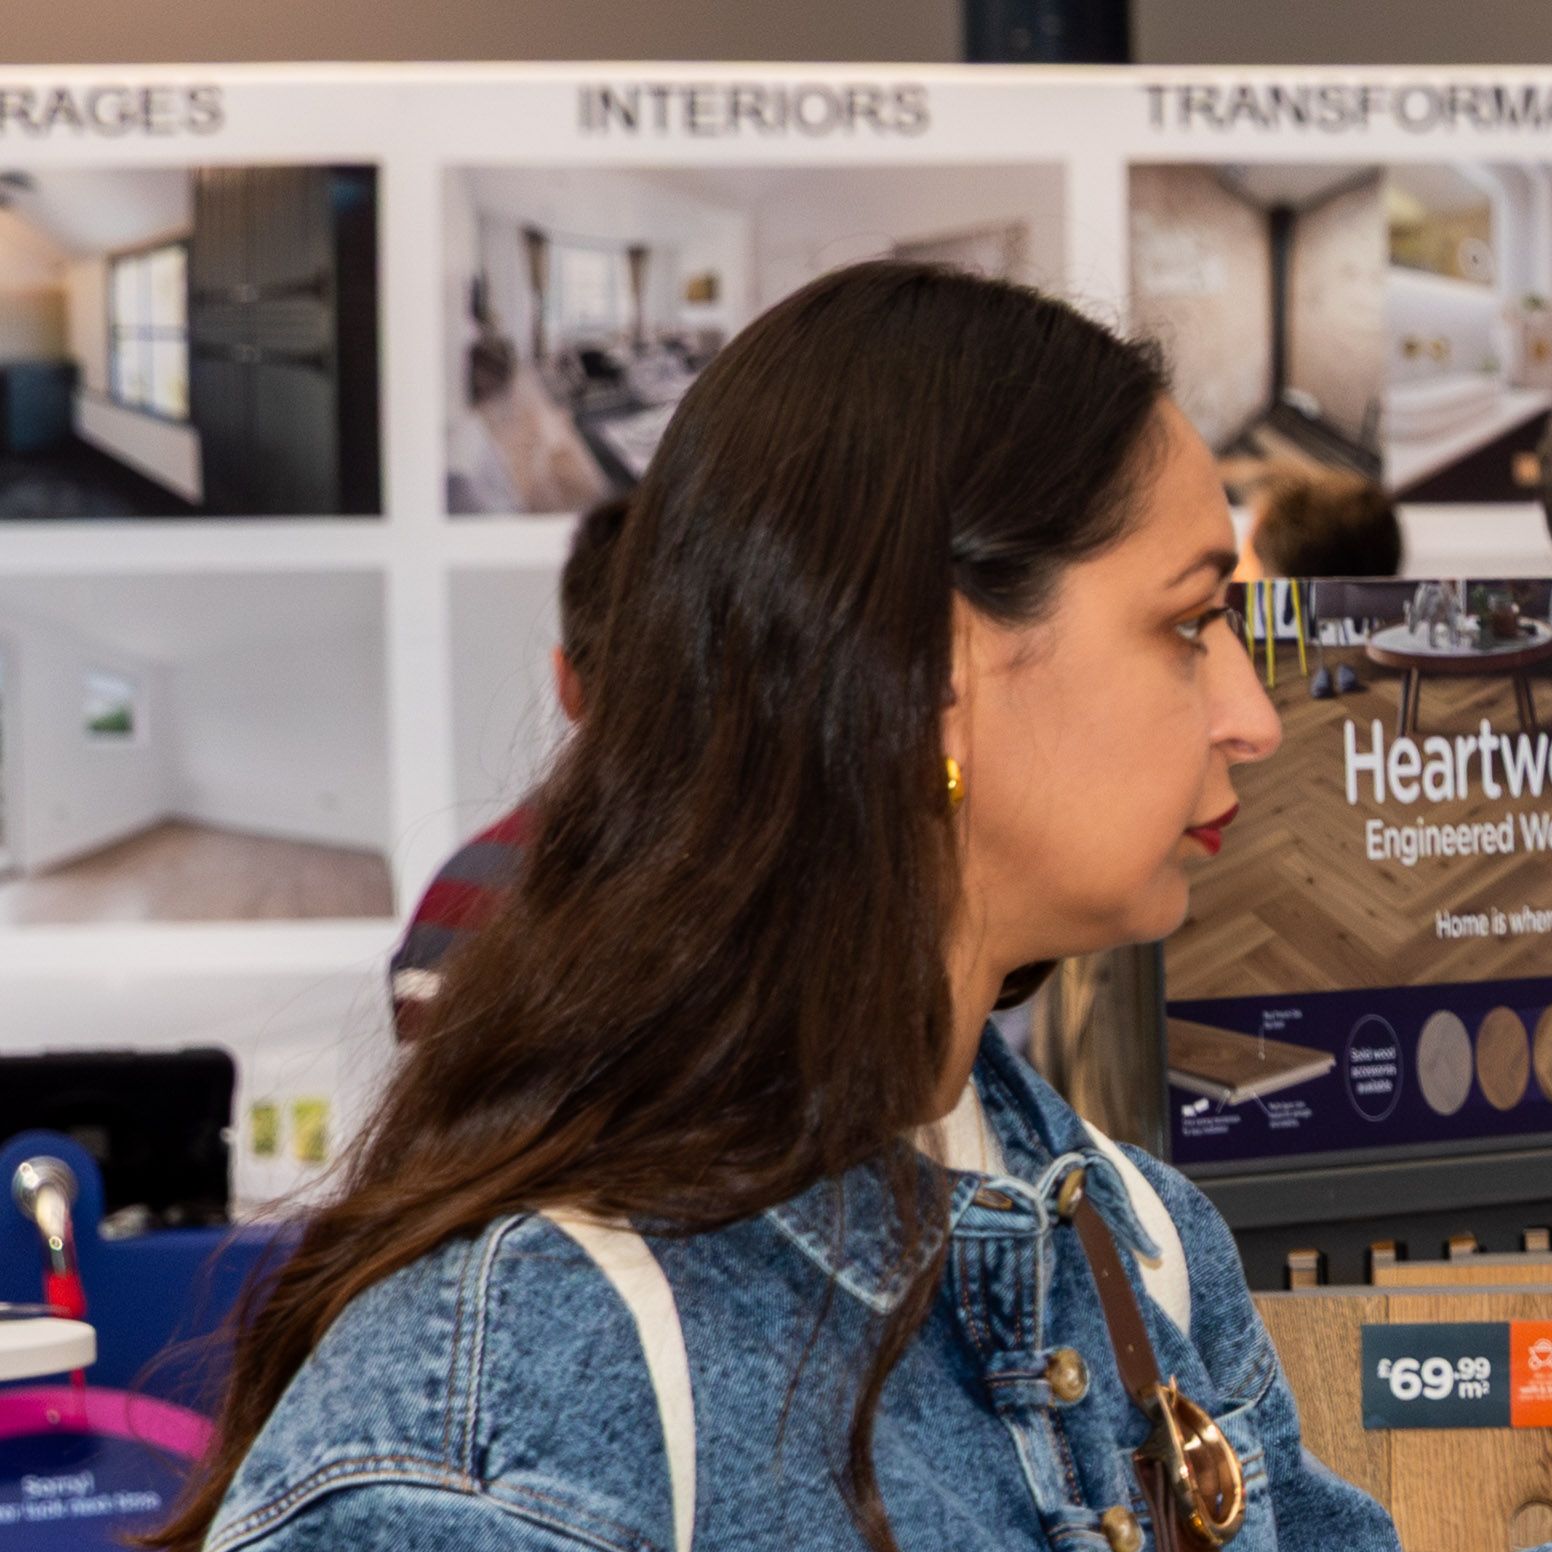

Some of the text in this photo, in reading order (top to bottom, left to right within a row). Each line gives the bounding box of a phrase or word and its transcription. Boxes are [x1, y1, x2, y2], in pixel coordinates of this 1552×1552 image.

[576, 82, 931, 136] INTERIORS
[1365, 812, 1515, 866] Engineered
[1436, 908, 1489, 939] Home
[1492, 907, 1507, 936] is
[1377, 1356, 1491, 1401] £69.99
[1458, 1380, 1490, 1399] m²
